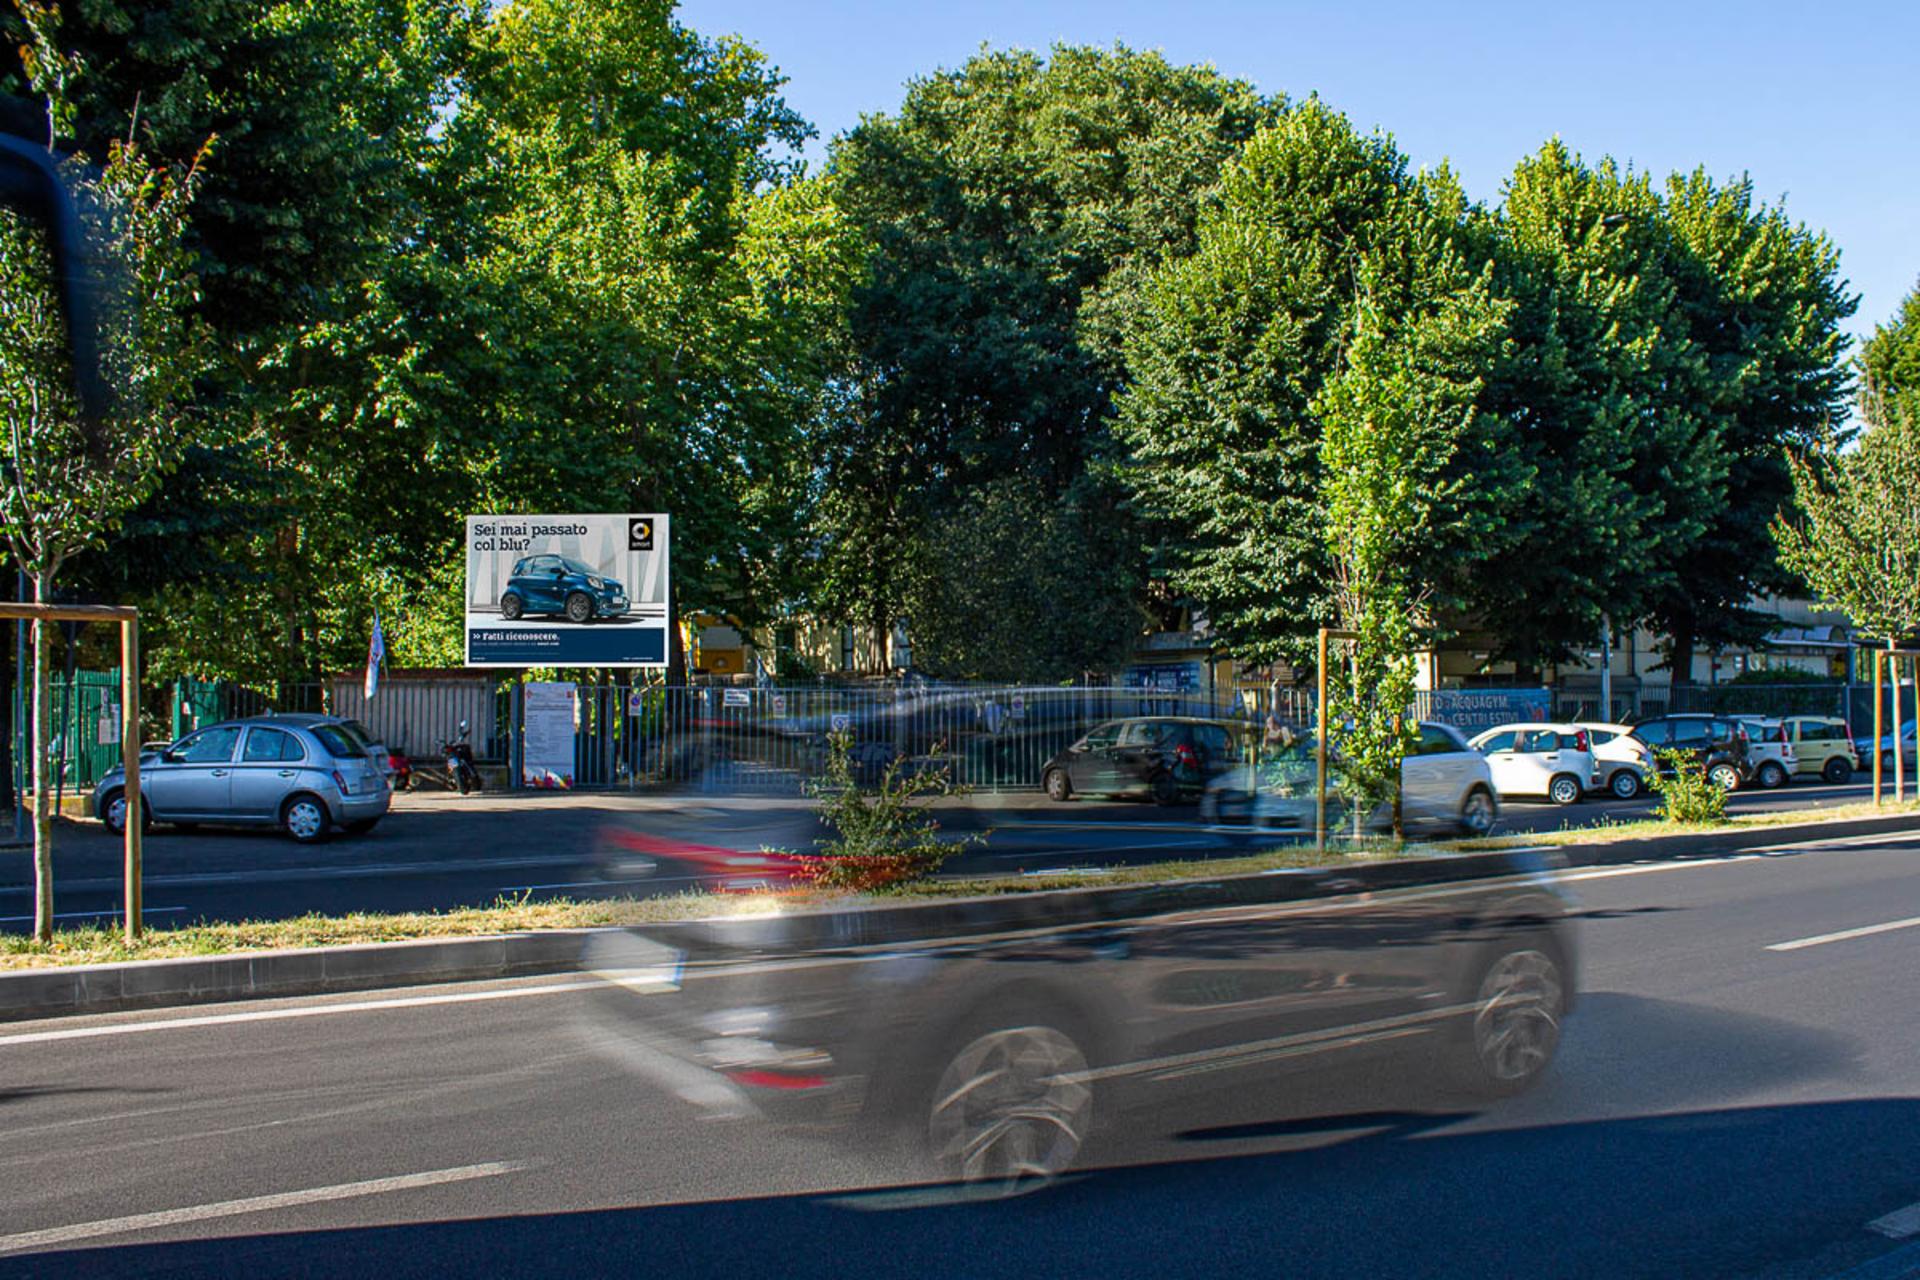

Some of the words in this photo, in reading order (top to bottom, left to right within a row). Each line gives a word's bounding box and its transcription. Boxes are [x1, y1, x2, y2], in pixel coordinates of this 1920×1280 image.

[474, 522, 496, 536] Sei
[500, 522, 527, 536] mai
[531, 523, 588, 539] passato
[474, 538, 495, 551] col
[499, 538, 531, 551] blu?
